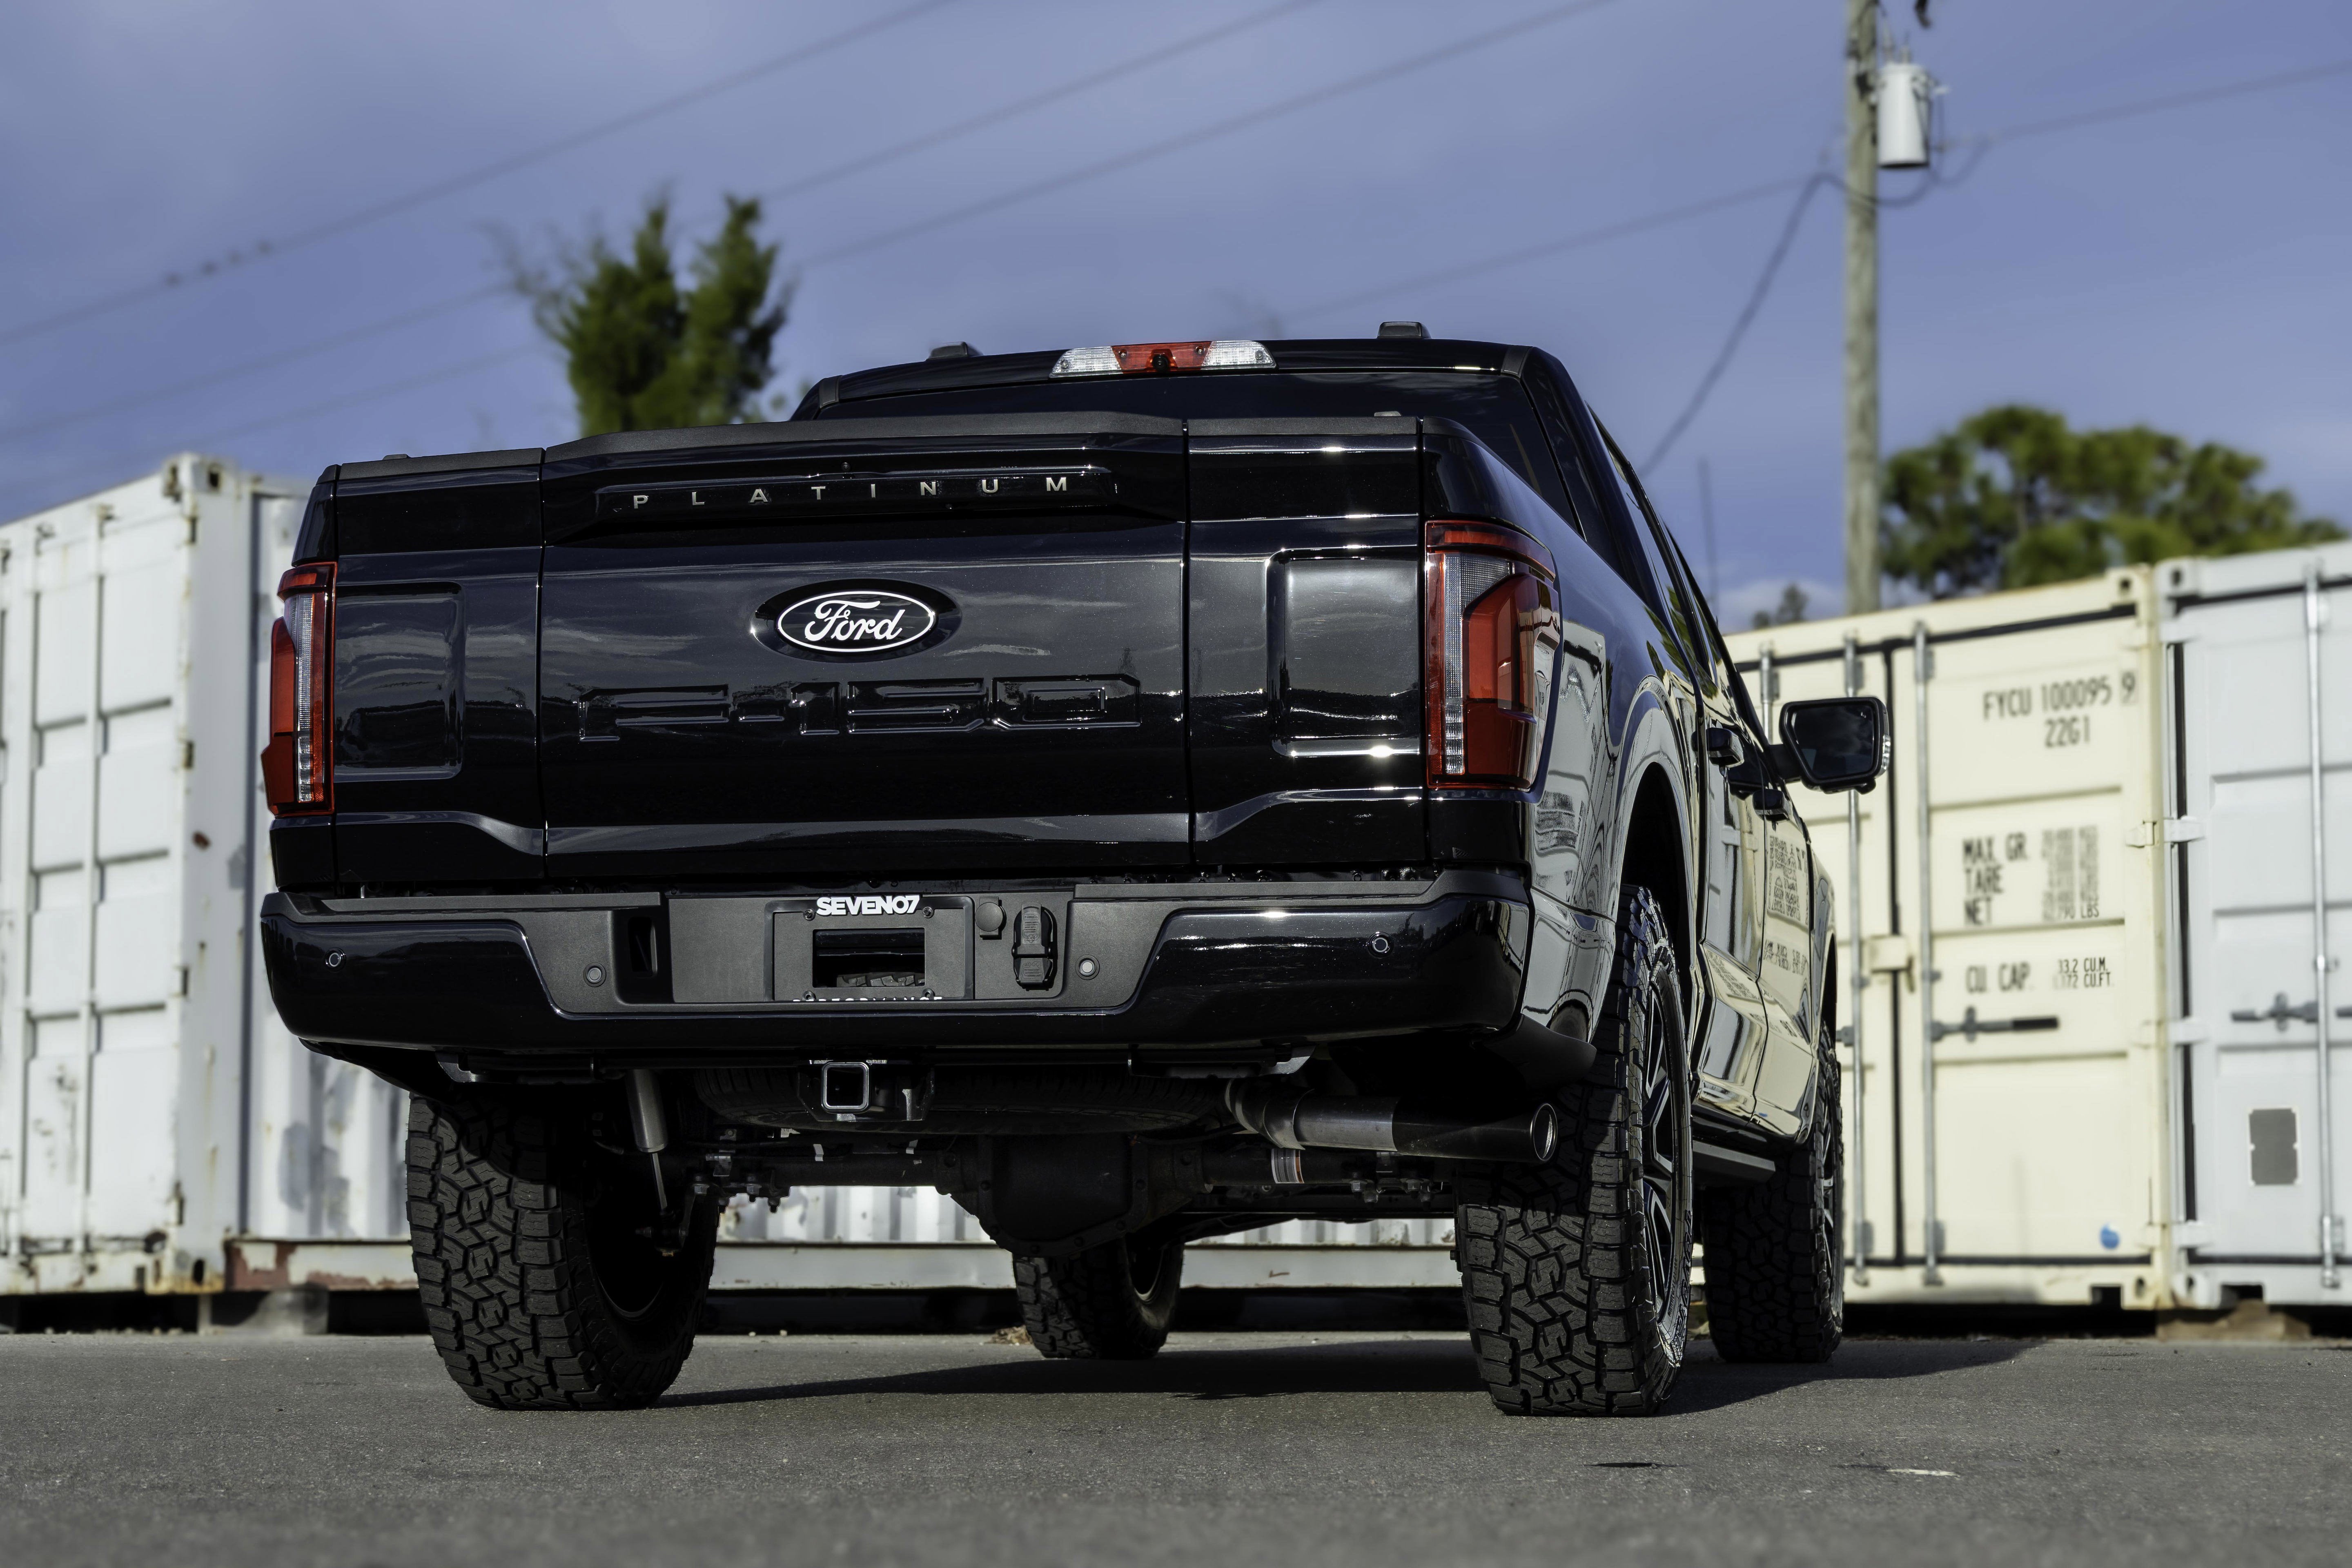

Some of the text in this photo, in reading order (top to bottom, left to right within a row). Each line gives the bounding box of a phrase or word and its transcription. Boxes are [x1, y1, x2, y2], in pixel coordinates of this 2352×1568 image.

[633, 476, 1068, 510] PLATINUM
[804, 600, 906, 641] Ford
[577, 673, 1142, 741] F-150
[1983, 671, 2136, 720] FYCU 100095 9
[2045, 715, 2090, 748] 22G1
[1965, 864, 2004, 895] TARE
[1964, 894, 1992, 926] NET
